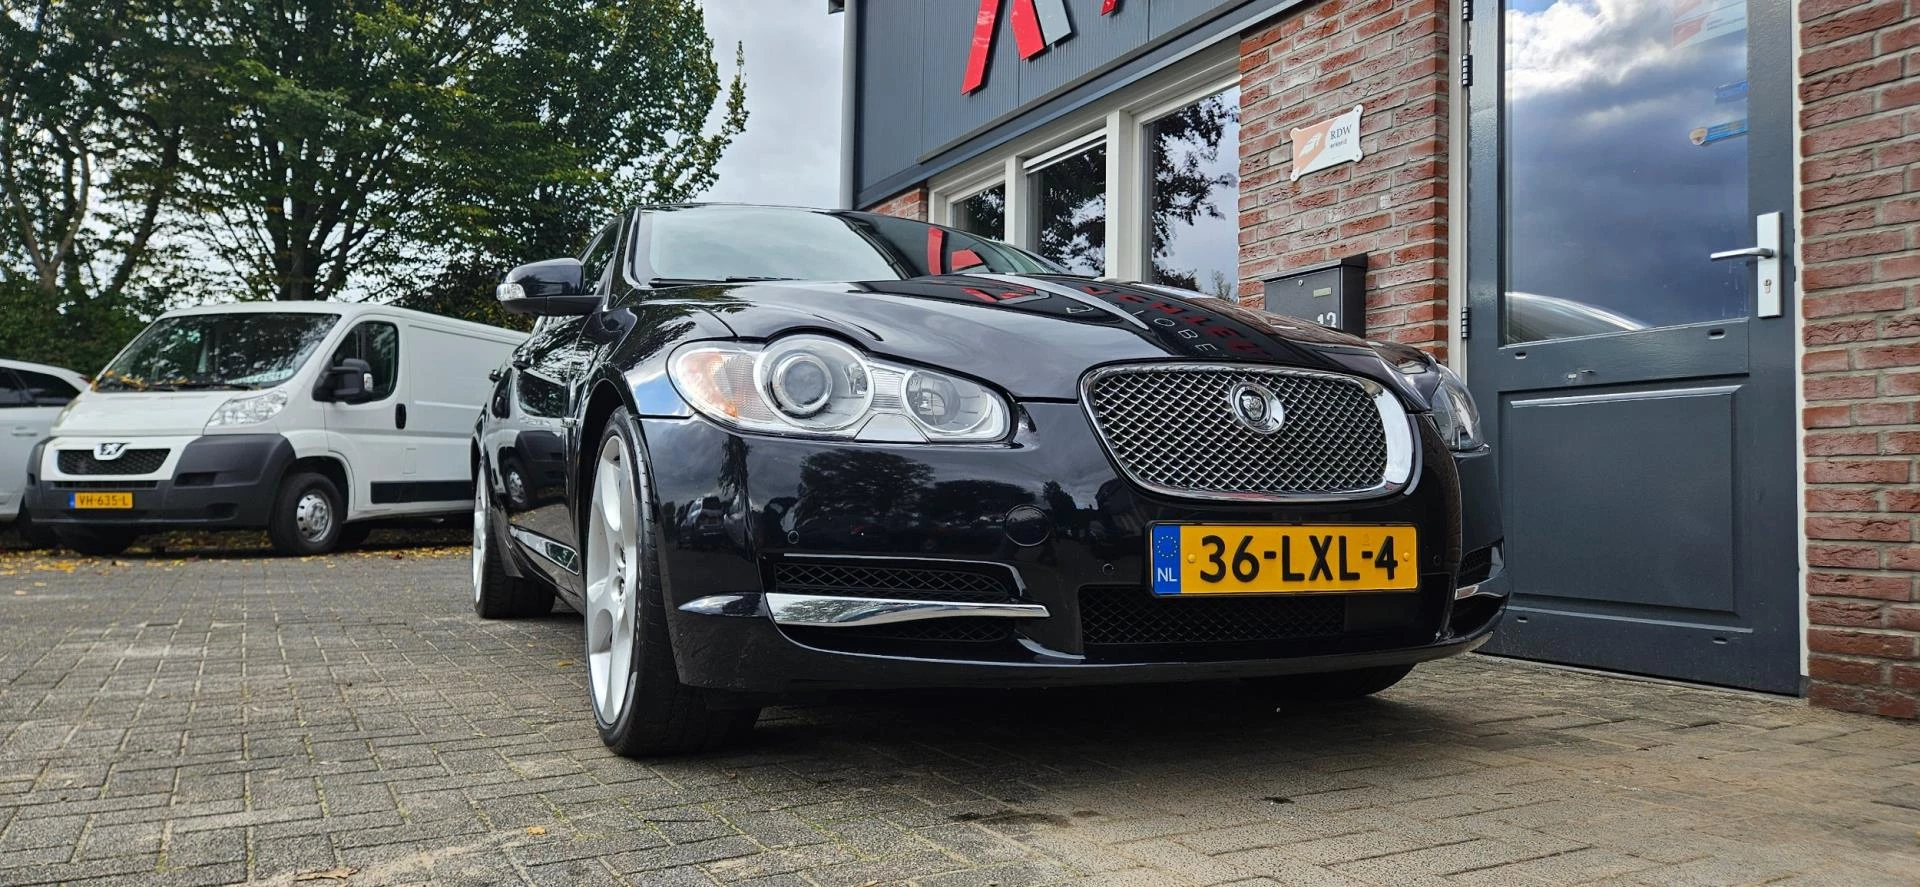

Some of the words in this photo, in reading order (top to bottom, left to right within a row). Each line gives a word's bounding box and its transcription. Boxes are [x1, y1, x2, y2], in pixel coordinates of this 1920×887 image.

[1330, 123, 1352, 140] RDW
[79, 495, 129, 506] VH-635-L
[1157, 567, 1177, 582] NL
[1200, 535, 1398, 583] 36-LXL-4
